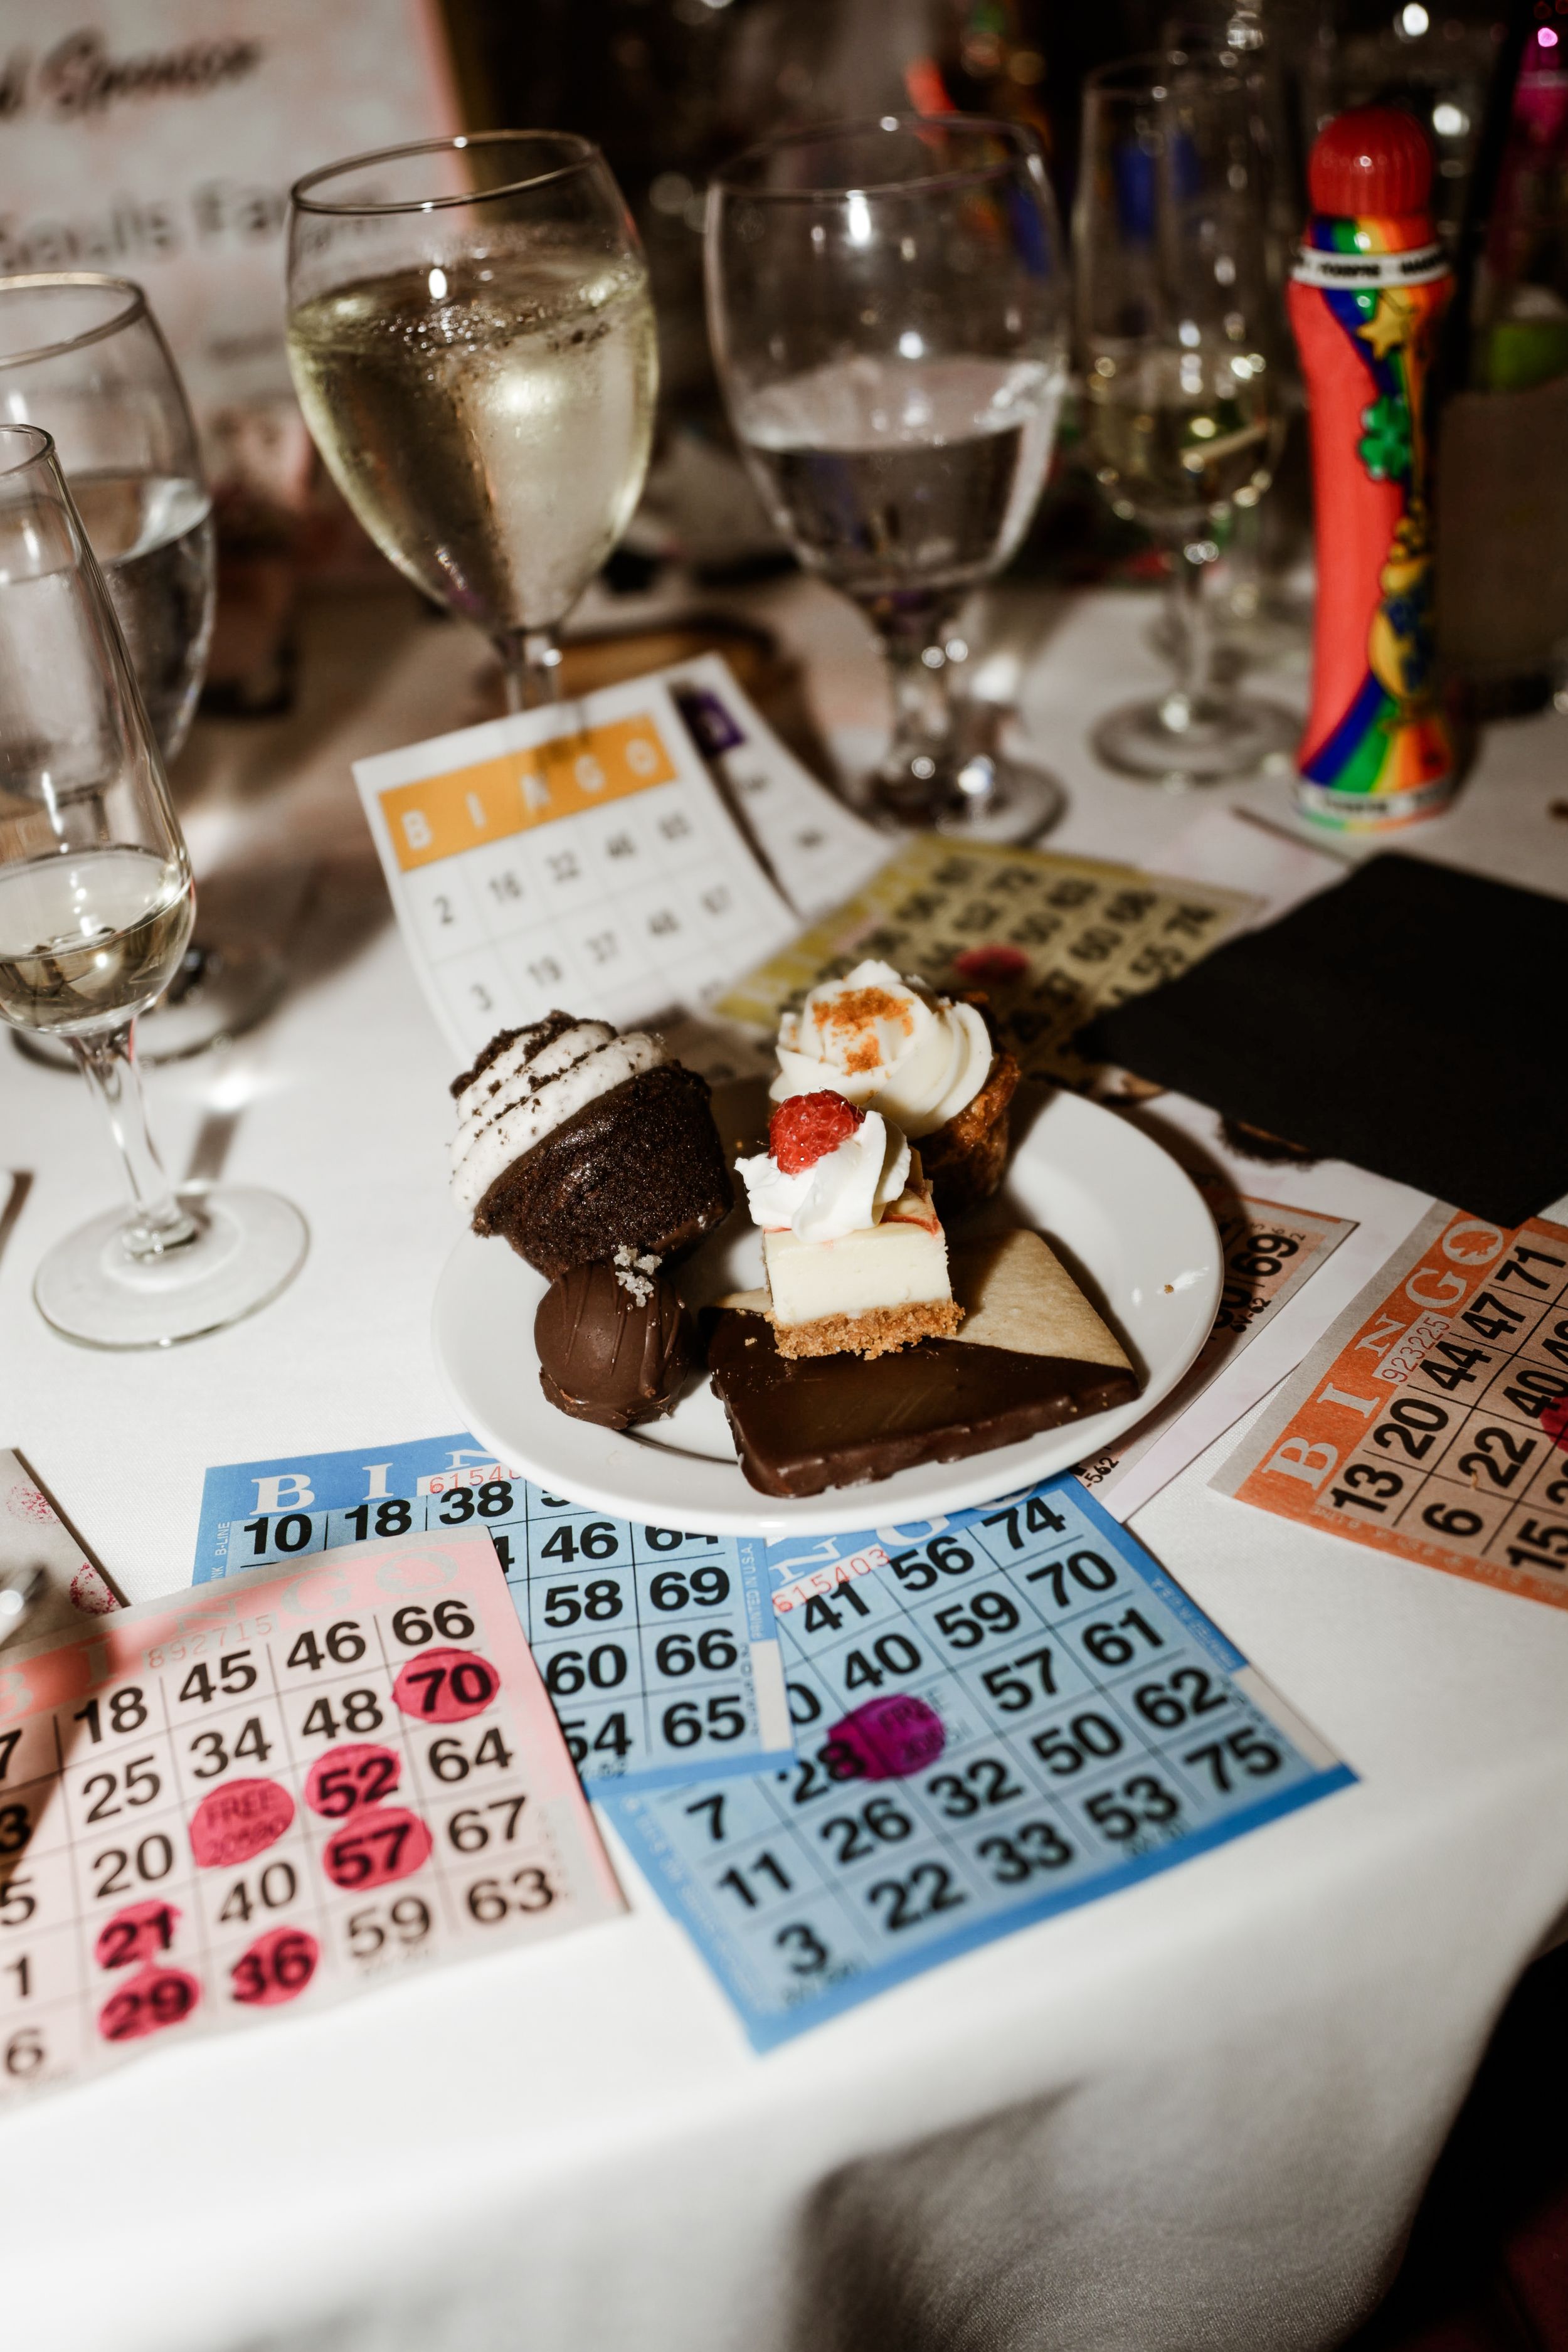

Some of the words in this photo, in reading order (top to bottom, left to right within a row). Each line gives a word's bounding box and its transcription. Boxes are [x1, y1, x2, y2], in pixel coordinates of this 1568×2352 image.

[432, 894, 454, 925] 2
[469, 983, 493, 1012] 3
[1230, 1233, 1300, 1278] 69
[1330, 1463, 1404, 1514] 13
[1372, 1397, 1449, 1461] 20
[1419, 1340, 1493, 1391] 44
[1461, 1291, 1527, 1340] 47
[1494, 1245, 1567, 1291] 71
[1381, 1317, 1450, 1382] 923225
[1421, 1502, 1483, 1537] 6
[1458, 1426, 1538, 1489] 22
[1502, 1369, 1568, 1420] 40
[215, 1522, 230, 1555] B-LINE
[243, 1513, 313, 1555] 10
[344, 1499, 413, 1542] 18
[439, 1480, 514, 1525] 38
[541, 1522, 619, 1564] 46
[1506, 1517, 1568, 1571] 15
[543, 1579, 623, 1629] 58
[649, 1567, 731, 1611] 69
[772, 1548, 891, 1613] 615403
[804, 1581, 871, 1634] 41
[890, 1535, 975, 1591] 56
[981, 1496, 1066, 1550] 74
[148, 1615, 275, 1669] 892715
[845, 1633, 922, 1690] 40
[934, 1591, 1020, 1649] 59
[1025, 1550, 1118, 1608] 70
[73, 1685, 148, 1745] 18
[178, 1650, 258, 1705] 45
[286, 1619, 368, 1671] 46
[391, 1599, 476, 1646] 66
[546, 1644, 628, 1696] 60
[655, 1629, 738, 1678] 66
[82, 1757, 161, 1824] 25
[189, 1717, 273, 1780] 34
[302, 1688, 384, 1740] 48
[406, 1660, 494, 1715] 70
[562, 1712, 633, 1763] 54
[662, 1696, 745, 1749] 65
[686, 1793, 726, 1841] 7
[793, 1740, 866, 1805] 28
[981, 1646, 1058, 1712] 57
[1081, 1607, 1164, 1666] 61
[92, 1832, 175, 1898] 20
[317, 1757, 400, 1819] 52
[428, 1727, 513, 1784] 64
[718, 1849, 792, 1908] 11
[820, 1798, 913, 1865] 26
[926, 1758, 1024, 1818] 32
[1030, 1712, 1123, 1777] 50
[1132, 1666, 1229, 1730] 62
[98, 1908, 176, 1969] 21
[218, 1860, 299, 1929] 40
[331, 1823, 411, 1890] 57
[448, 1794, 526, 1853] 67
[775, 1920, 829, 1976] 3
[867, 1863, 968, 1932] 22
[976, 1821, 1074, 1883] 33
[1083, 1774, 1180, 1841] 53
[1182, 1726, 1285, 1794] 75
[6, 2027, 45, 2075] 6
[100, 1976, 194, 2042] 29
[230, 1934, 315, 2003] 36
[348, 1895, 431, 1959] 59
[467, 1867, 554, 1925] 63
